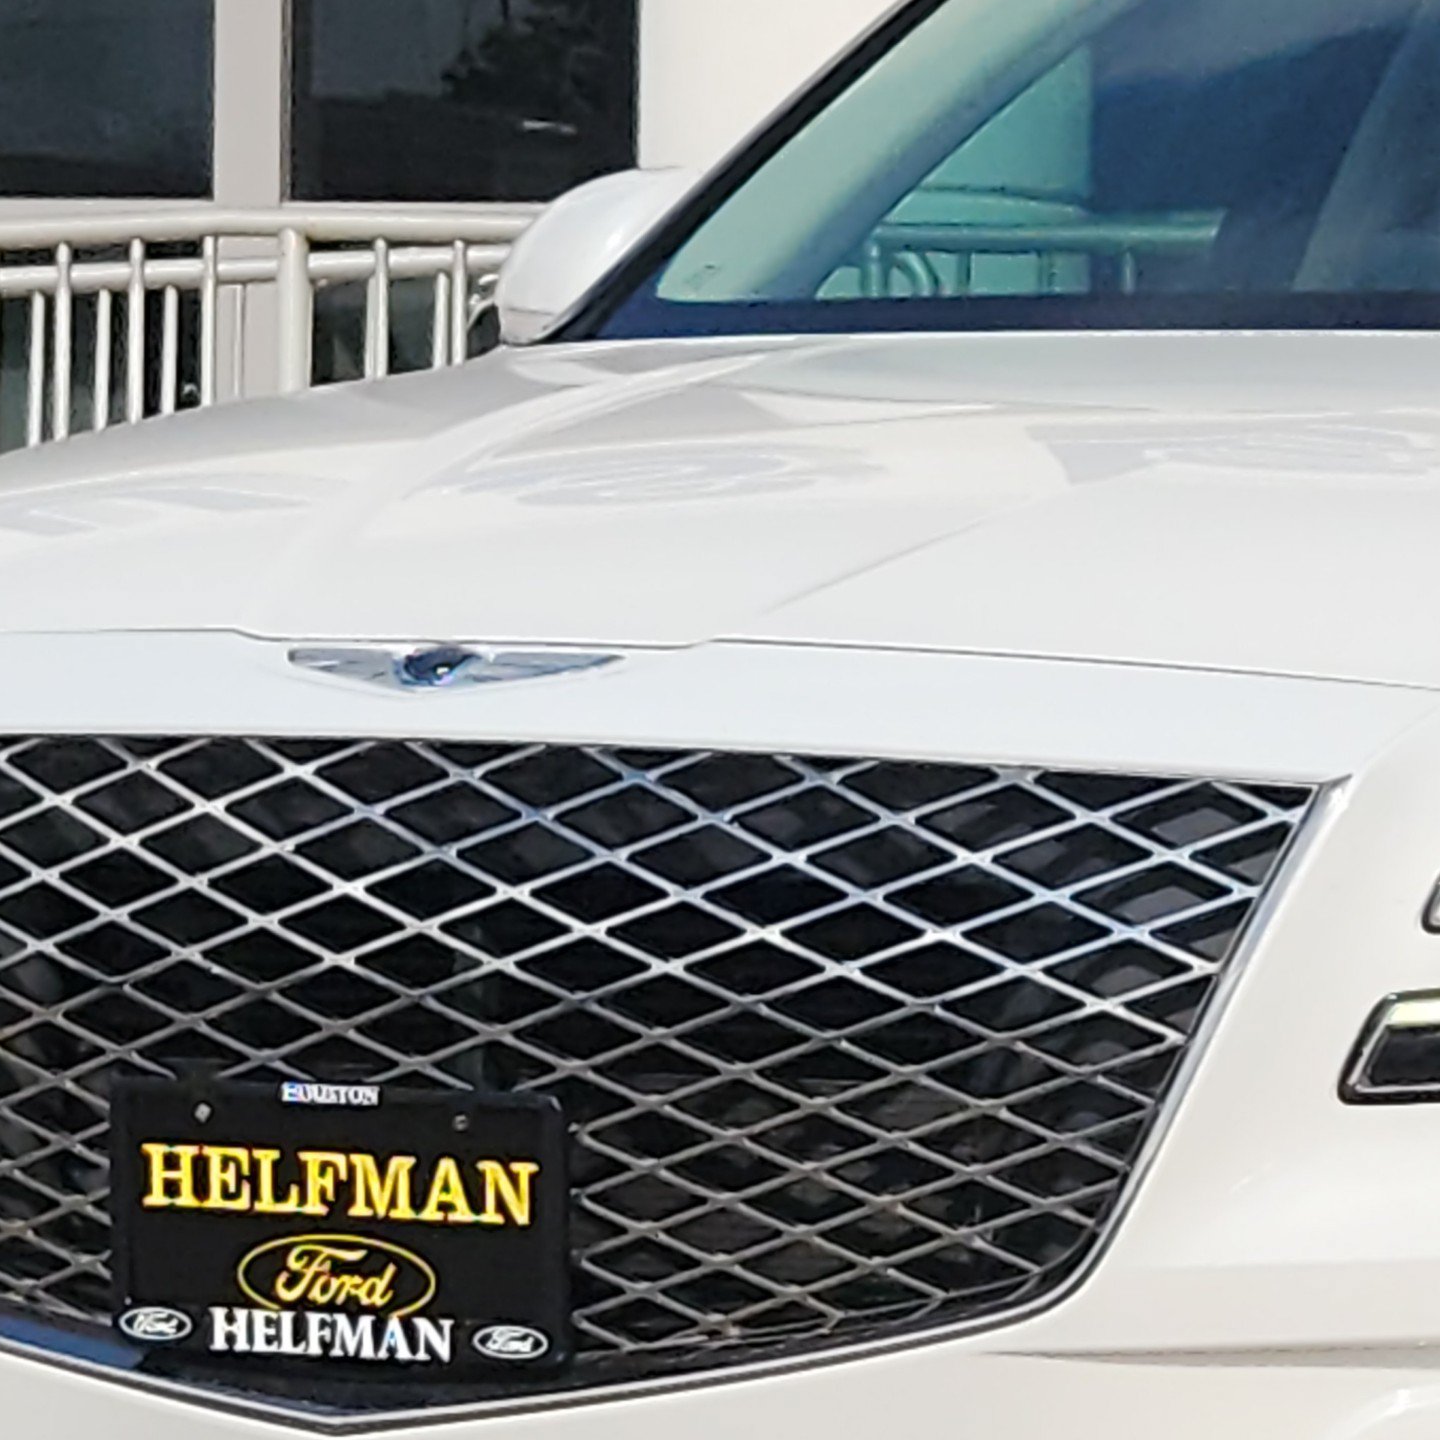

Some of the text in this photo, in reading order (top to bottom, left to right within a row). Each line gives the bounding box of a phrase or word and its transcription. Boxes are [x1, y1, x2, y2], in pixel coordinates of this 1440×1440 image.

[141, 1142, 540, 1227] HELFMAN
[275, 1244, 397, 1308] Ford
[208, 1306, 455, 1363] HELFMAN
